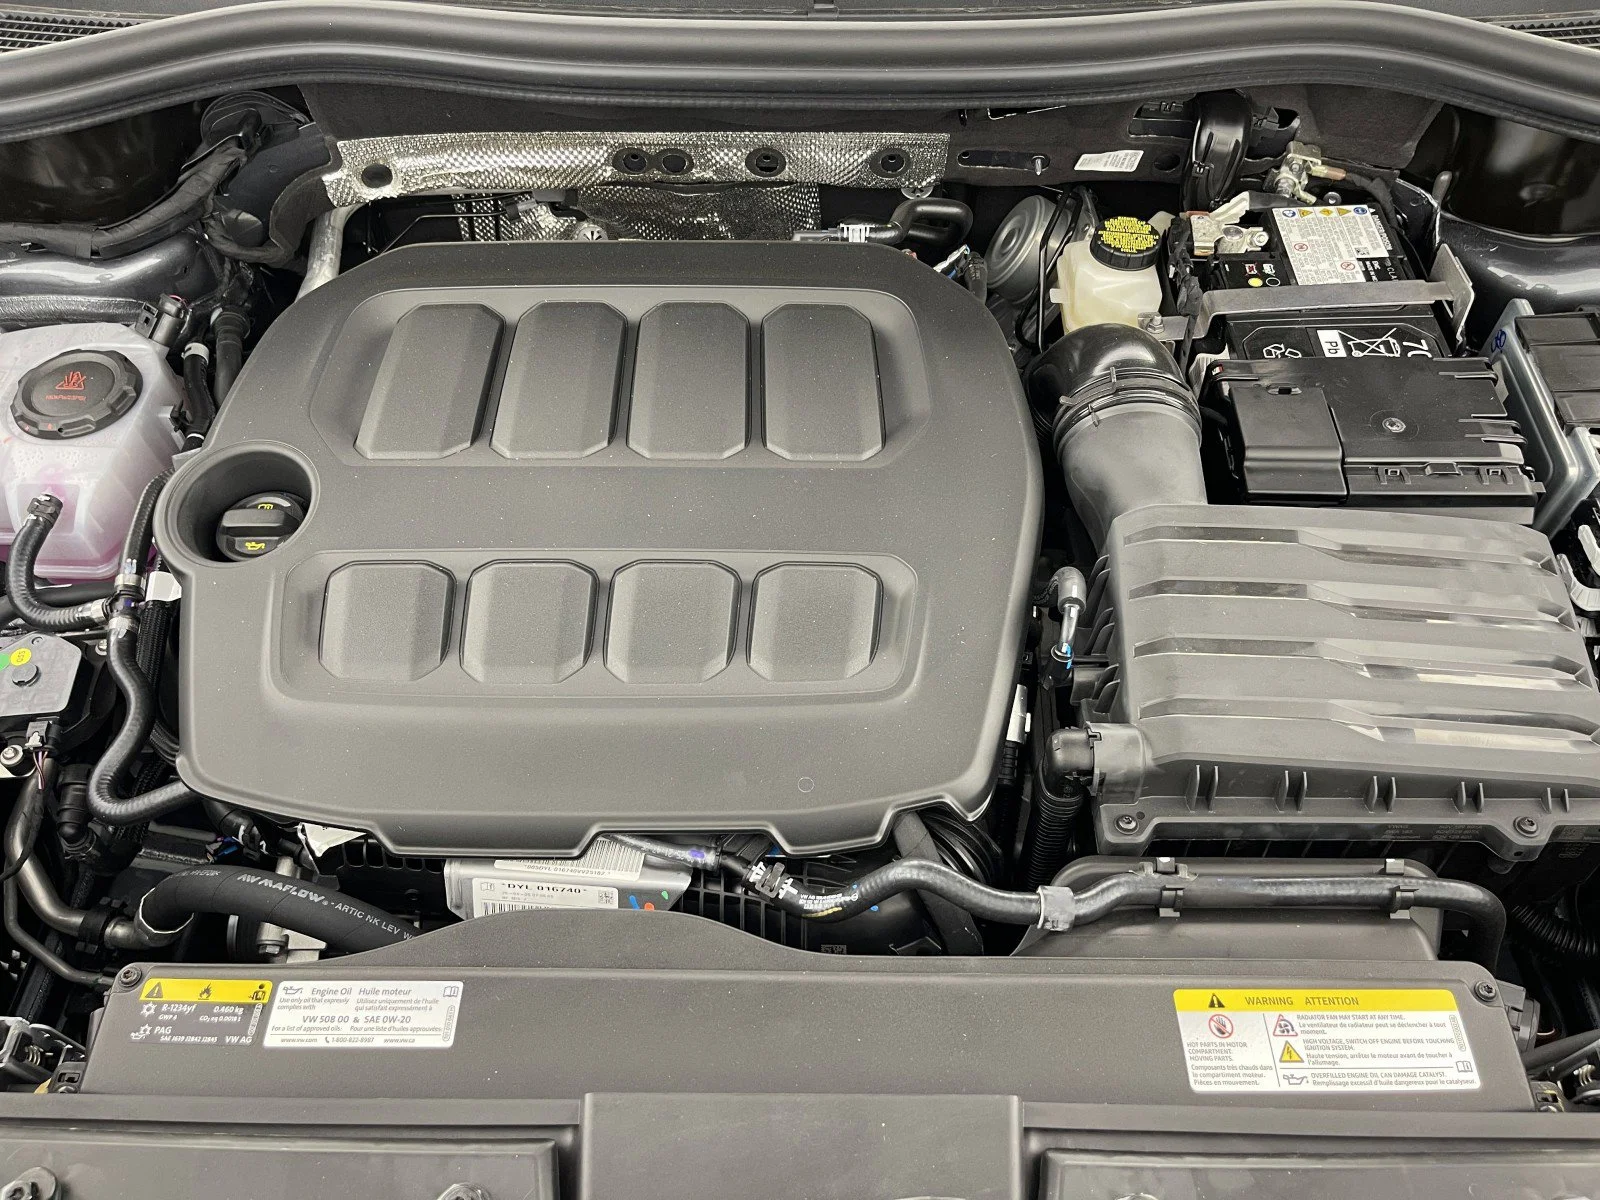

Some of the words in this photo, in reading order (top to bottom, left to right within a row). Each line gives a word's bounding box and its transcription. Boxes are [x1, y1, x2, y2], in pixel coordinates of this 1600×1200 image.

[1325, 341, 1340, 355] Pb
[366, 914, 381, 926] NK
[382, 921, 401, 935] LEV
[311, 987, 339, 998] Engine
[340, 987, 353, 996] Oil
[358, 987, 380, 996] Huile
[381, 988, 412, 996] moteur
[291, 997, 302, 1005] only
[1244, 996, 1294, 1006] WARNING
[1305, 996, 1359, 1006] ATTENTION
[162, 1003, 197, 1014] R-1234yf
[234, 1005, 244, 1015] kg
[354, 1004, 364, 1012] qui
[302, 1015, 319, 1023] VW
[320, 1015, 336, 1023] 508
[337, 1015, 350, 1023] 00
[364, 1015, 381, 1023] SAE
[382, 1015, 412, 1023] 0W-20
[154, 1026, 172, 1035] PAG
[303, 1025, 330, 1033] approved
[225, 1035, 239, 1044] VW
[240, 1036, 253, 1044] AG
[1312, 1079, 1349, 1087] Remplissage
